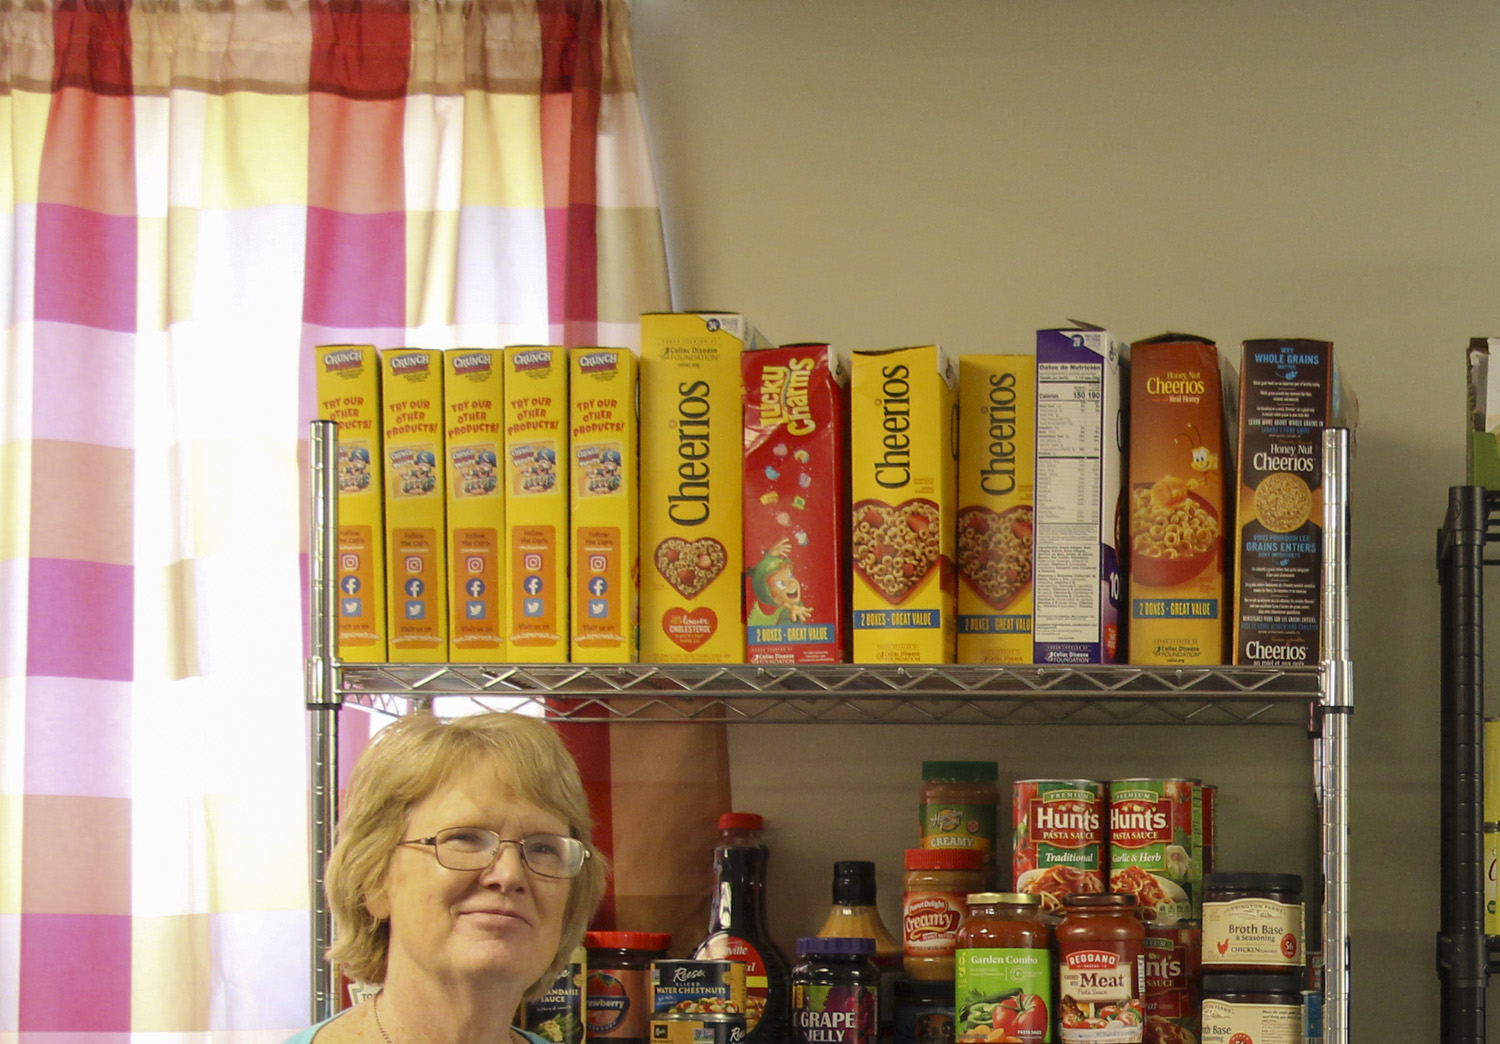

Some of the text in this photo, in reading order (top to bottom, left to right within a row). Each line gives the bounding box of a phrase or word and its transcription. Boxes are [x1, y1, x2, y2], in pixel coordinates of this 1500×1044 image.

[325, 352, 362, 365] CRUNCH
[579, 353, 617, 367] CRUNCH
[1255, 355, 1319, 365] WHOLE GRAINS
[1147, 378, 1204, 394] Cheerios
[787, 358, 816, 436] Charms
[511, 399, 529, 409] TRY
[517, 409, 546, 421] OTHER
[508, 421, 559, 435] PRODUCTS!
[874, 364, 910, 490] Cheerios
[980, 372, 1017, 496] Cheerios
[669, 380, 711, 527] Cheerios
[1271, 445, 1312, 455] Honey Nut
[1254, 454, 1314, 471] Cheerios
[1247, 542, 1316, 552] GRAINS ENTIERS
[1139, 602, 1210, 615] 2 BOXES GREAT VALUE
[1246, 641, 1306, 660] Cheerios
[1050, 792, 1089, 800] PREMIUM
[1037, 807, 1098, 831] Hunt's
[1111, 807, 1166, 831] Hunt's
[931, 837, 974, 847] CREAMY
[1045, 853, 1093, 863] Traditional
[1139, 853, 1160, 862] Herb
[1229, 924, 1283, 935] Broth Base
[1242, 935, 1275, 943] Seasoning
[971, 955, 1038, 965] Garden Combo
[1070, 954, 1114, 966] REGGANO
[1081, 973, 1124, 988] Meat
[801, 1012, 856, 1028] GRAPE
[806, 1030, 845, 1042] JELLY
